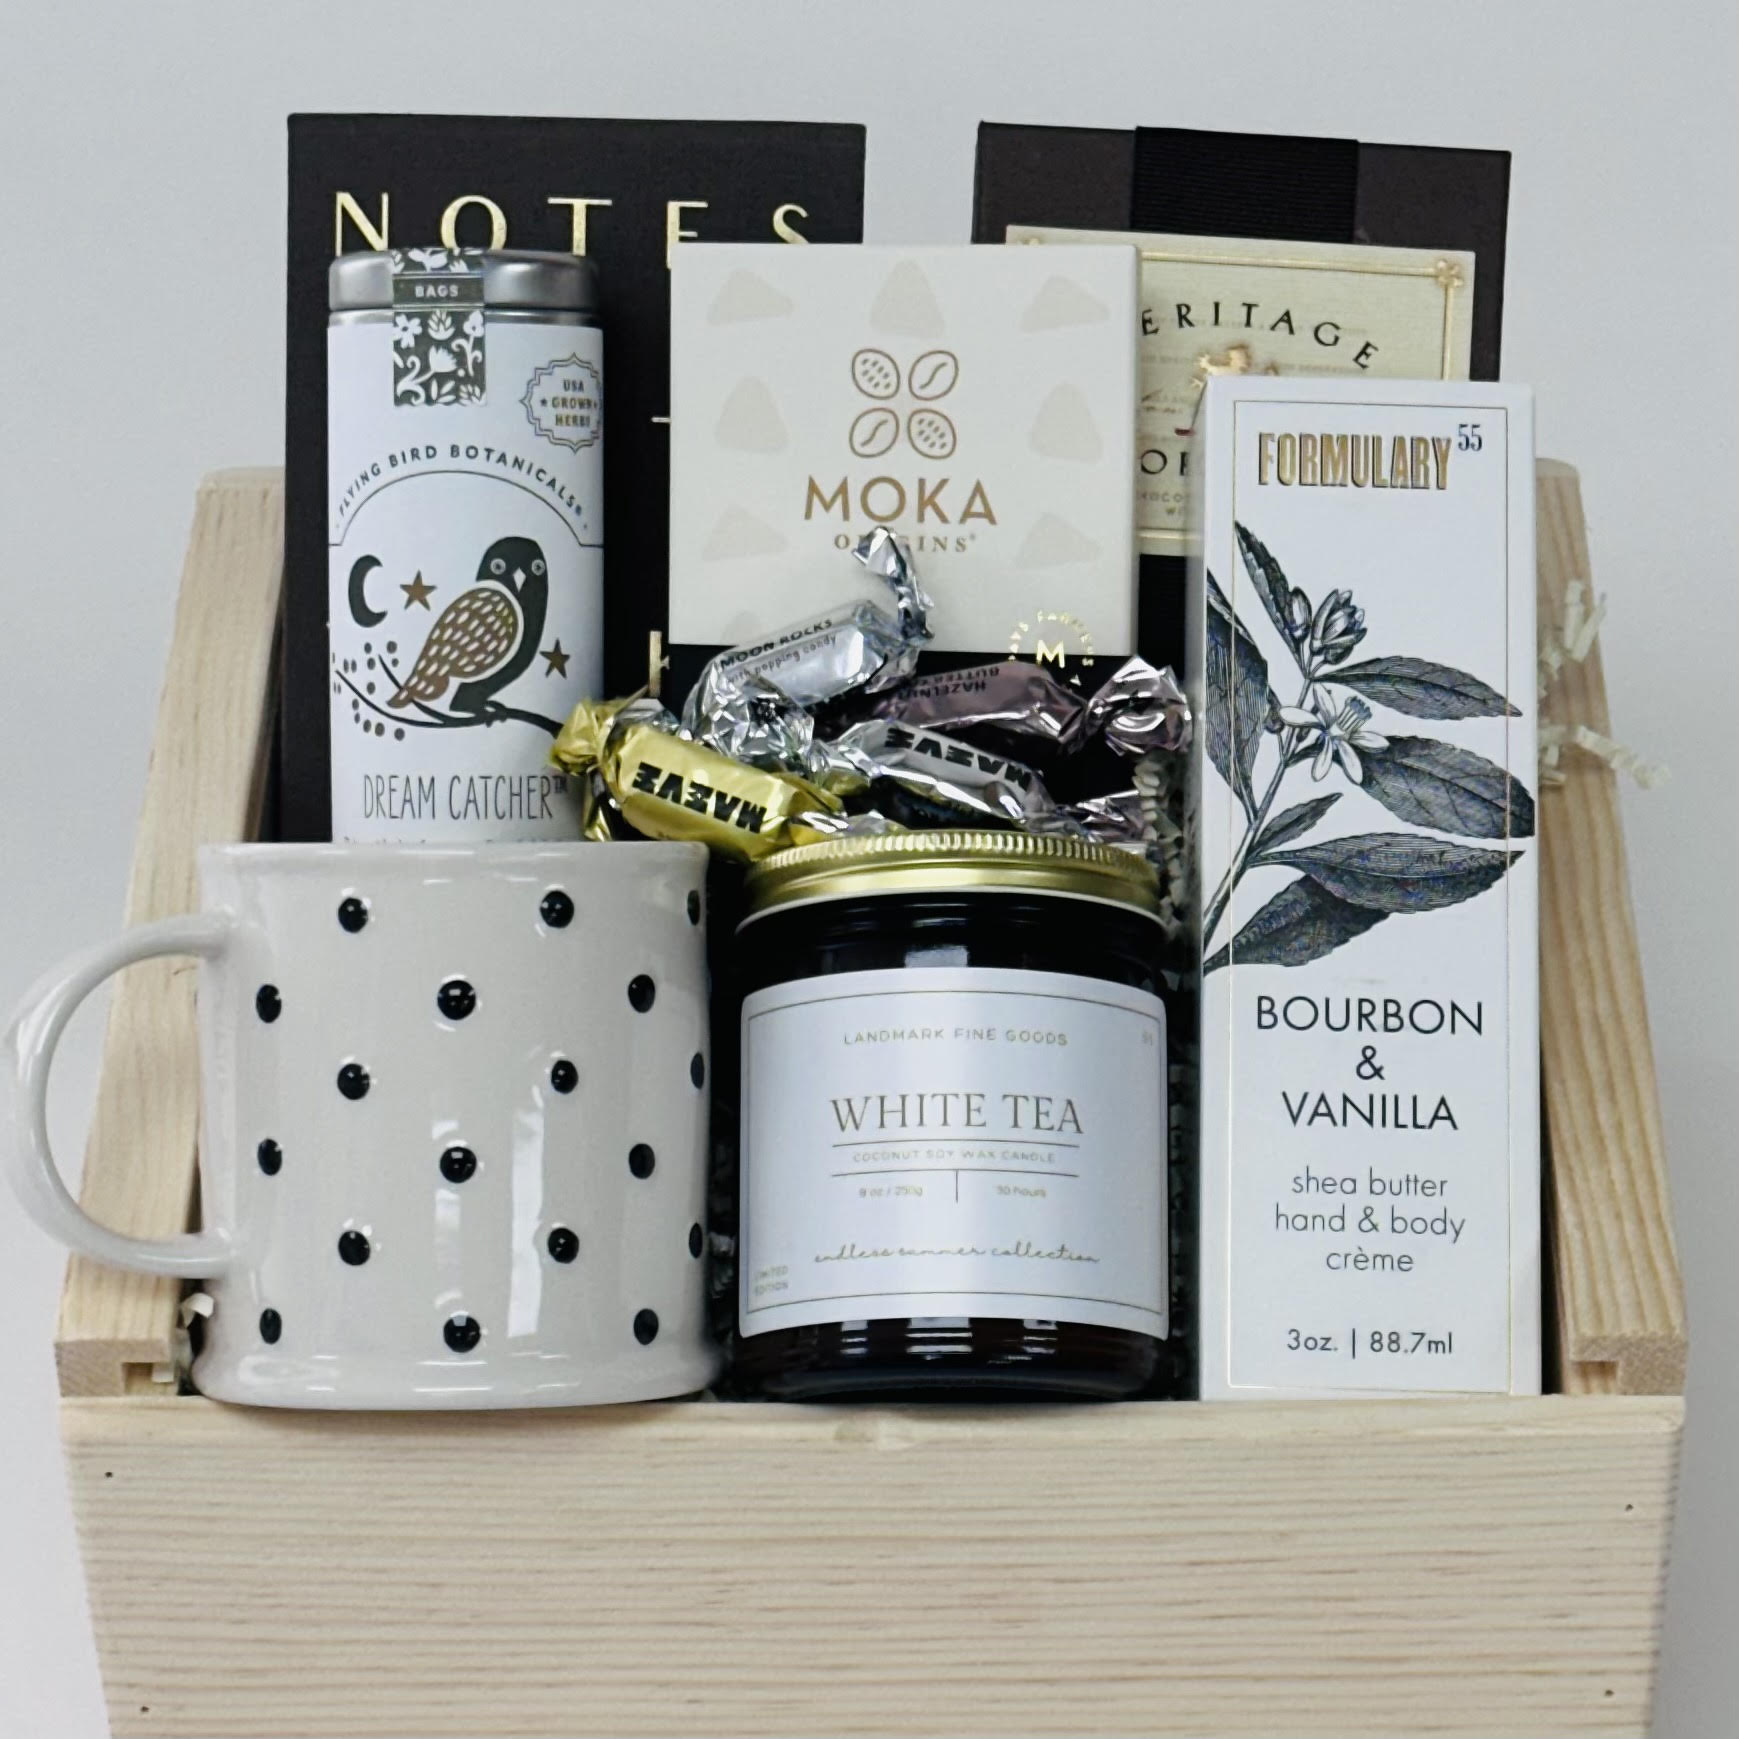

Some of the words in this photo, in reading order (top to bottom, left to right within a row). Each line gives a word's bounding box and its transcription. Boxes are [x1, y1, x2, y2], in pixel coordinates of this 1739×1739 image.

[334, 192, 811, 269] NOTES
[415, 284, 460, 298] BAGS
[1140, 302, 1378, 370] ERITAGE
[563, 379, 585, 393] USA
[1258, 431, 1452, 490] FORMULARY
[1457, 423, 1483, 452] 55
[339, 462, 382, 518] FLYING
[388, 445, 438, 469] BIRD
[804, 475, 998, 526] MOKA
[834, 533, 968, 553] OINS
[720, 641, 775, 669] MOON
[779, 618, 833, 645] ROCKS
[754, 650, 801, 676] popping
[803, 633, 837, 656] candy
[886, 725, 1032, 789] MAEVE
[363, 773, 436, 821] DREAM
[632, 761, 767, 833] MAEVE
[1256, 995, 1483, 1036] BOURBON
[843, 1028, 945, 1045] LANDMARK
[954, 1027, 997, 1041] FINE
[1005, 1029, 1068, 1047] GOODS
[1355, 1045, 1386, 1081] &
[830, 1092, 988, 1133] WHITE
[1001, 1093, 1085, 1134] TEA
[1281, 1090, 1459, 1131] VANILLA
[852, 1150, 919, 1163] COCONUT
[925, 1149, 956, 1160] SOY
[962, 1149, 997, 1160] WAX
[1002, 1150, 1056, 1163] CANDLE
[1291, 1165, 1358, 1197] shea
[1368, 1166, 1449, 1198] butter
[1275, 1202, 1346, 1234] hand
[1357, 1205, 1380, 1234] &
[1390, 1205, 1466, 1245] body
[814, 1243, 891, 1264] endless
[990, 1240, 1101, 1265] collection
[1325, 1246, 1415, 1273] crème
[1286, 1328, 1339, 1353] 3oz.
[1369, 1330, 1454, 1356] 88.7ml
